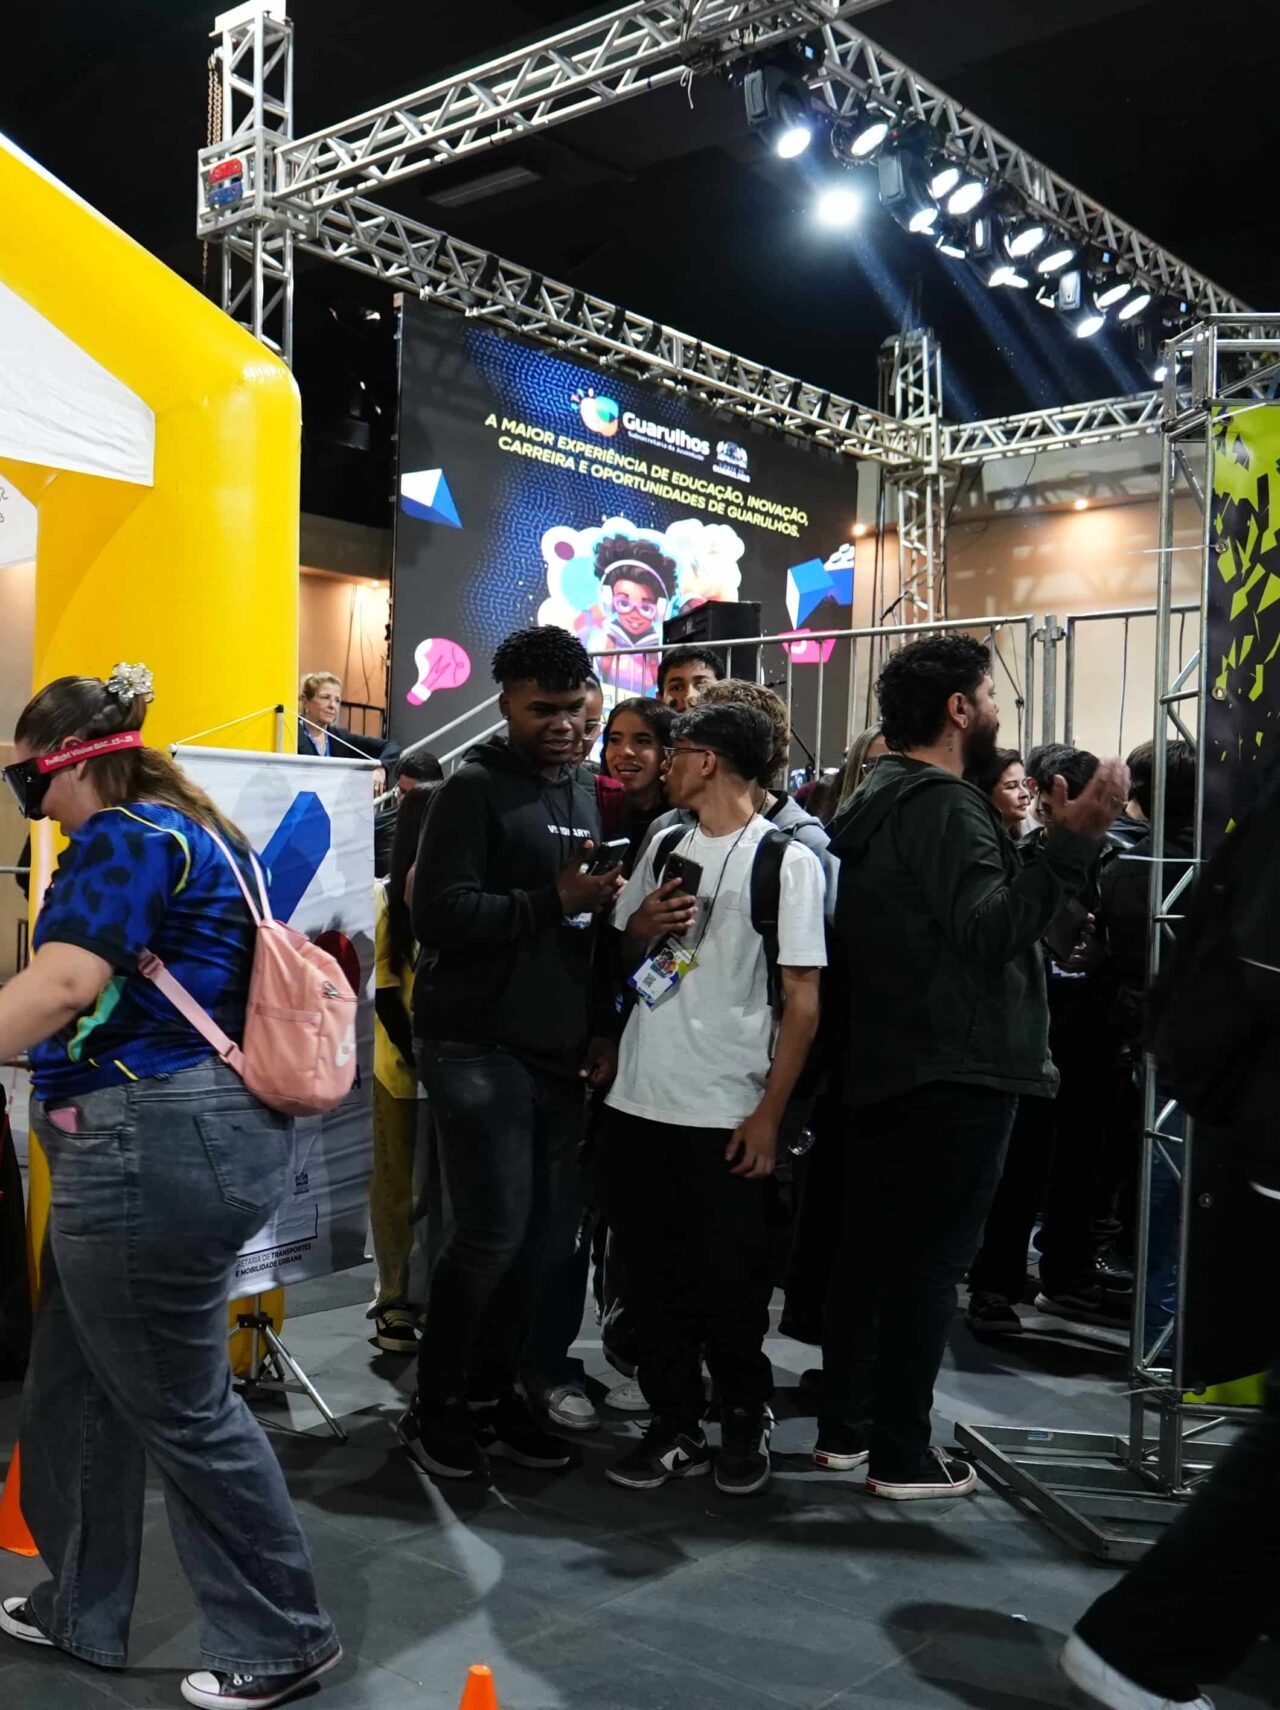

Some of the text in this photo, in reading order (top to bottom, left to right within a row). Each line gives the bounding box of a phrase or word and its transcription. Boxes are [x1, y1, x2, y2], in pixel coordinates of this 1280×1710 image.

[622, 411, 710, 456] Guarulhos
[484, 413, 809, 526] A MAIOR EXPERIÊNCIA DE EDUCAÇÃO, INOVAÇÃO,
[498, 436, 800, 538] CARREIRA E OPORTUNIDADES DE GUARULHOS.
[235, 1254, 303, 1278] E MOBILIDADE URBANA
[262, 1253, 271, 1262] DE
[271, 1243, 312, 1259] TRANSPORTES
